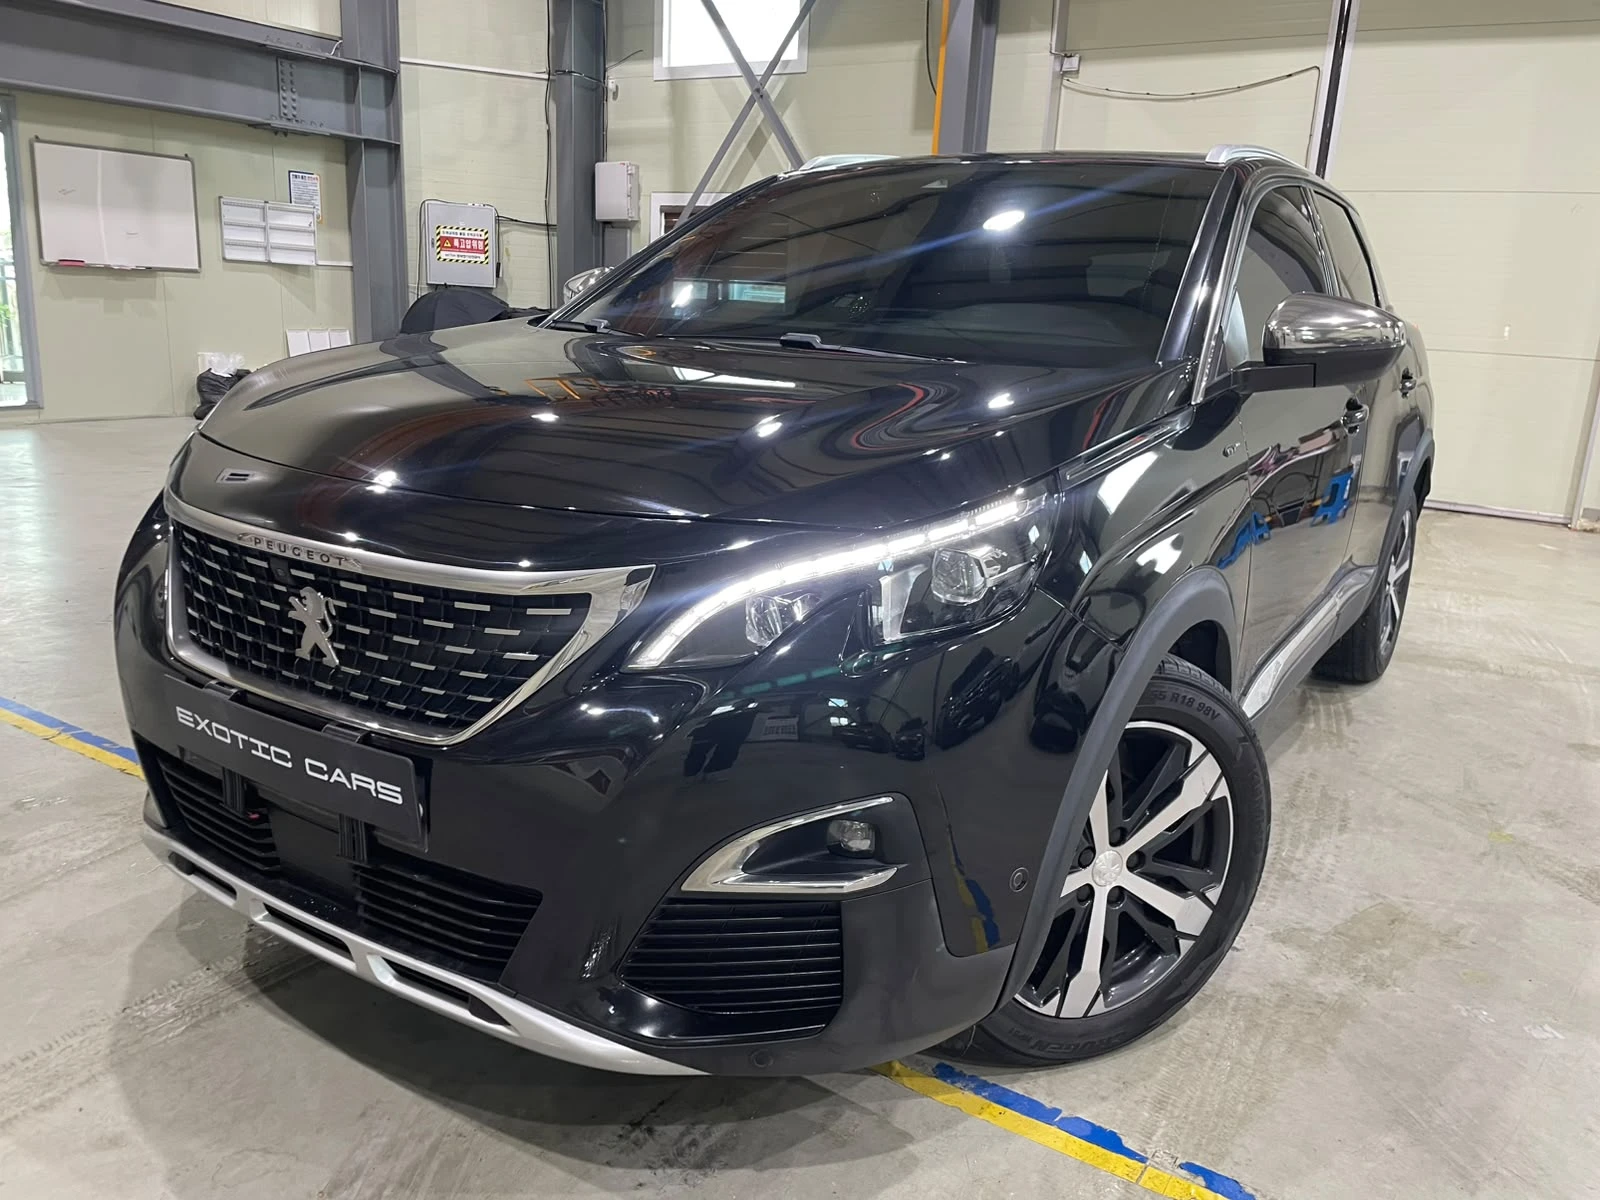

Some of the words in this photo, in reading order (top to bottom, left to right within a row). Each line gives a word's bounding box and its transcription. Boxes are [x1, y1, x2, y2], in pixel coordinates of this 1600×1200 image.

[253, 537, 345, 566] PEUGEOT
[1170, 691, 1196, 708] R18
[1196, 701, 1221, 721] 98V
[175, 706, 293, 768] EXOTIC
[304, 758, 403, 805] CARS
